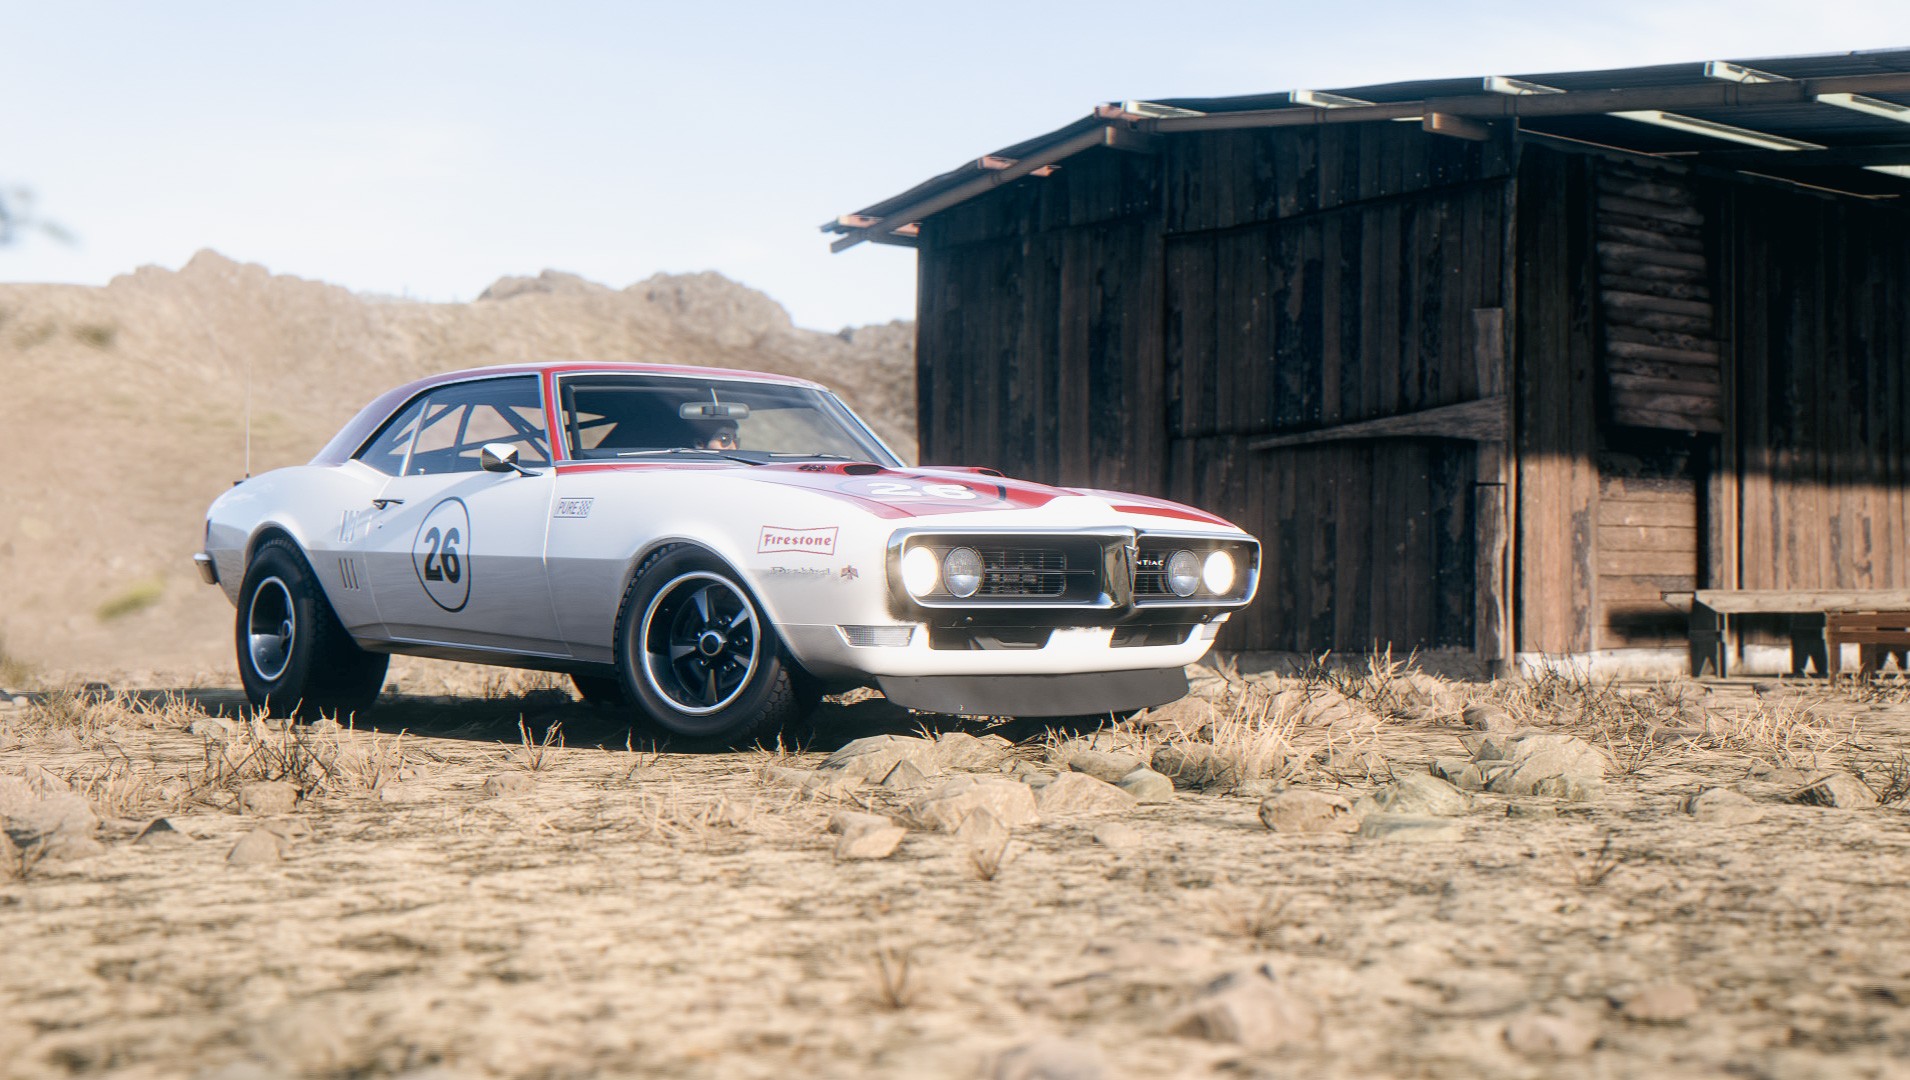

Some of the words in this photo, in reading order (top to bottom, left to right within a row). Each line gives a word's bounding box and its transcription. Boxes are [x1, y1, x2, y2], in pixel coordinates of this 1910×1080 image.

[867, 482, 977, 500] 26
[764, 533, 832, 546] Firestone
[424, 526, 461, 584] 26
